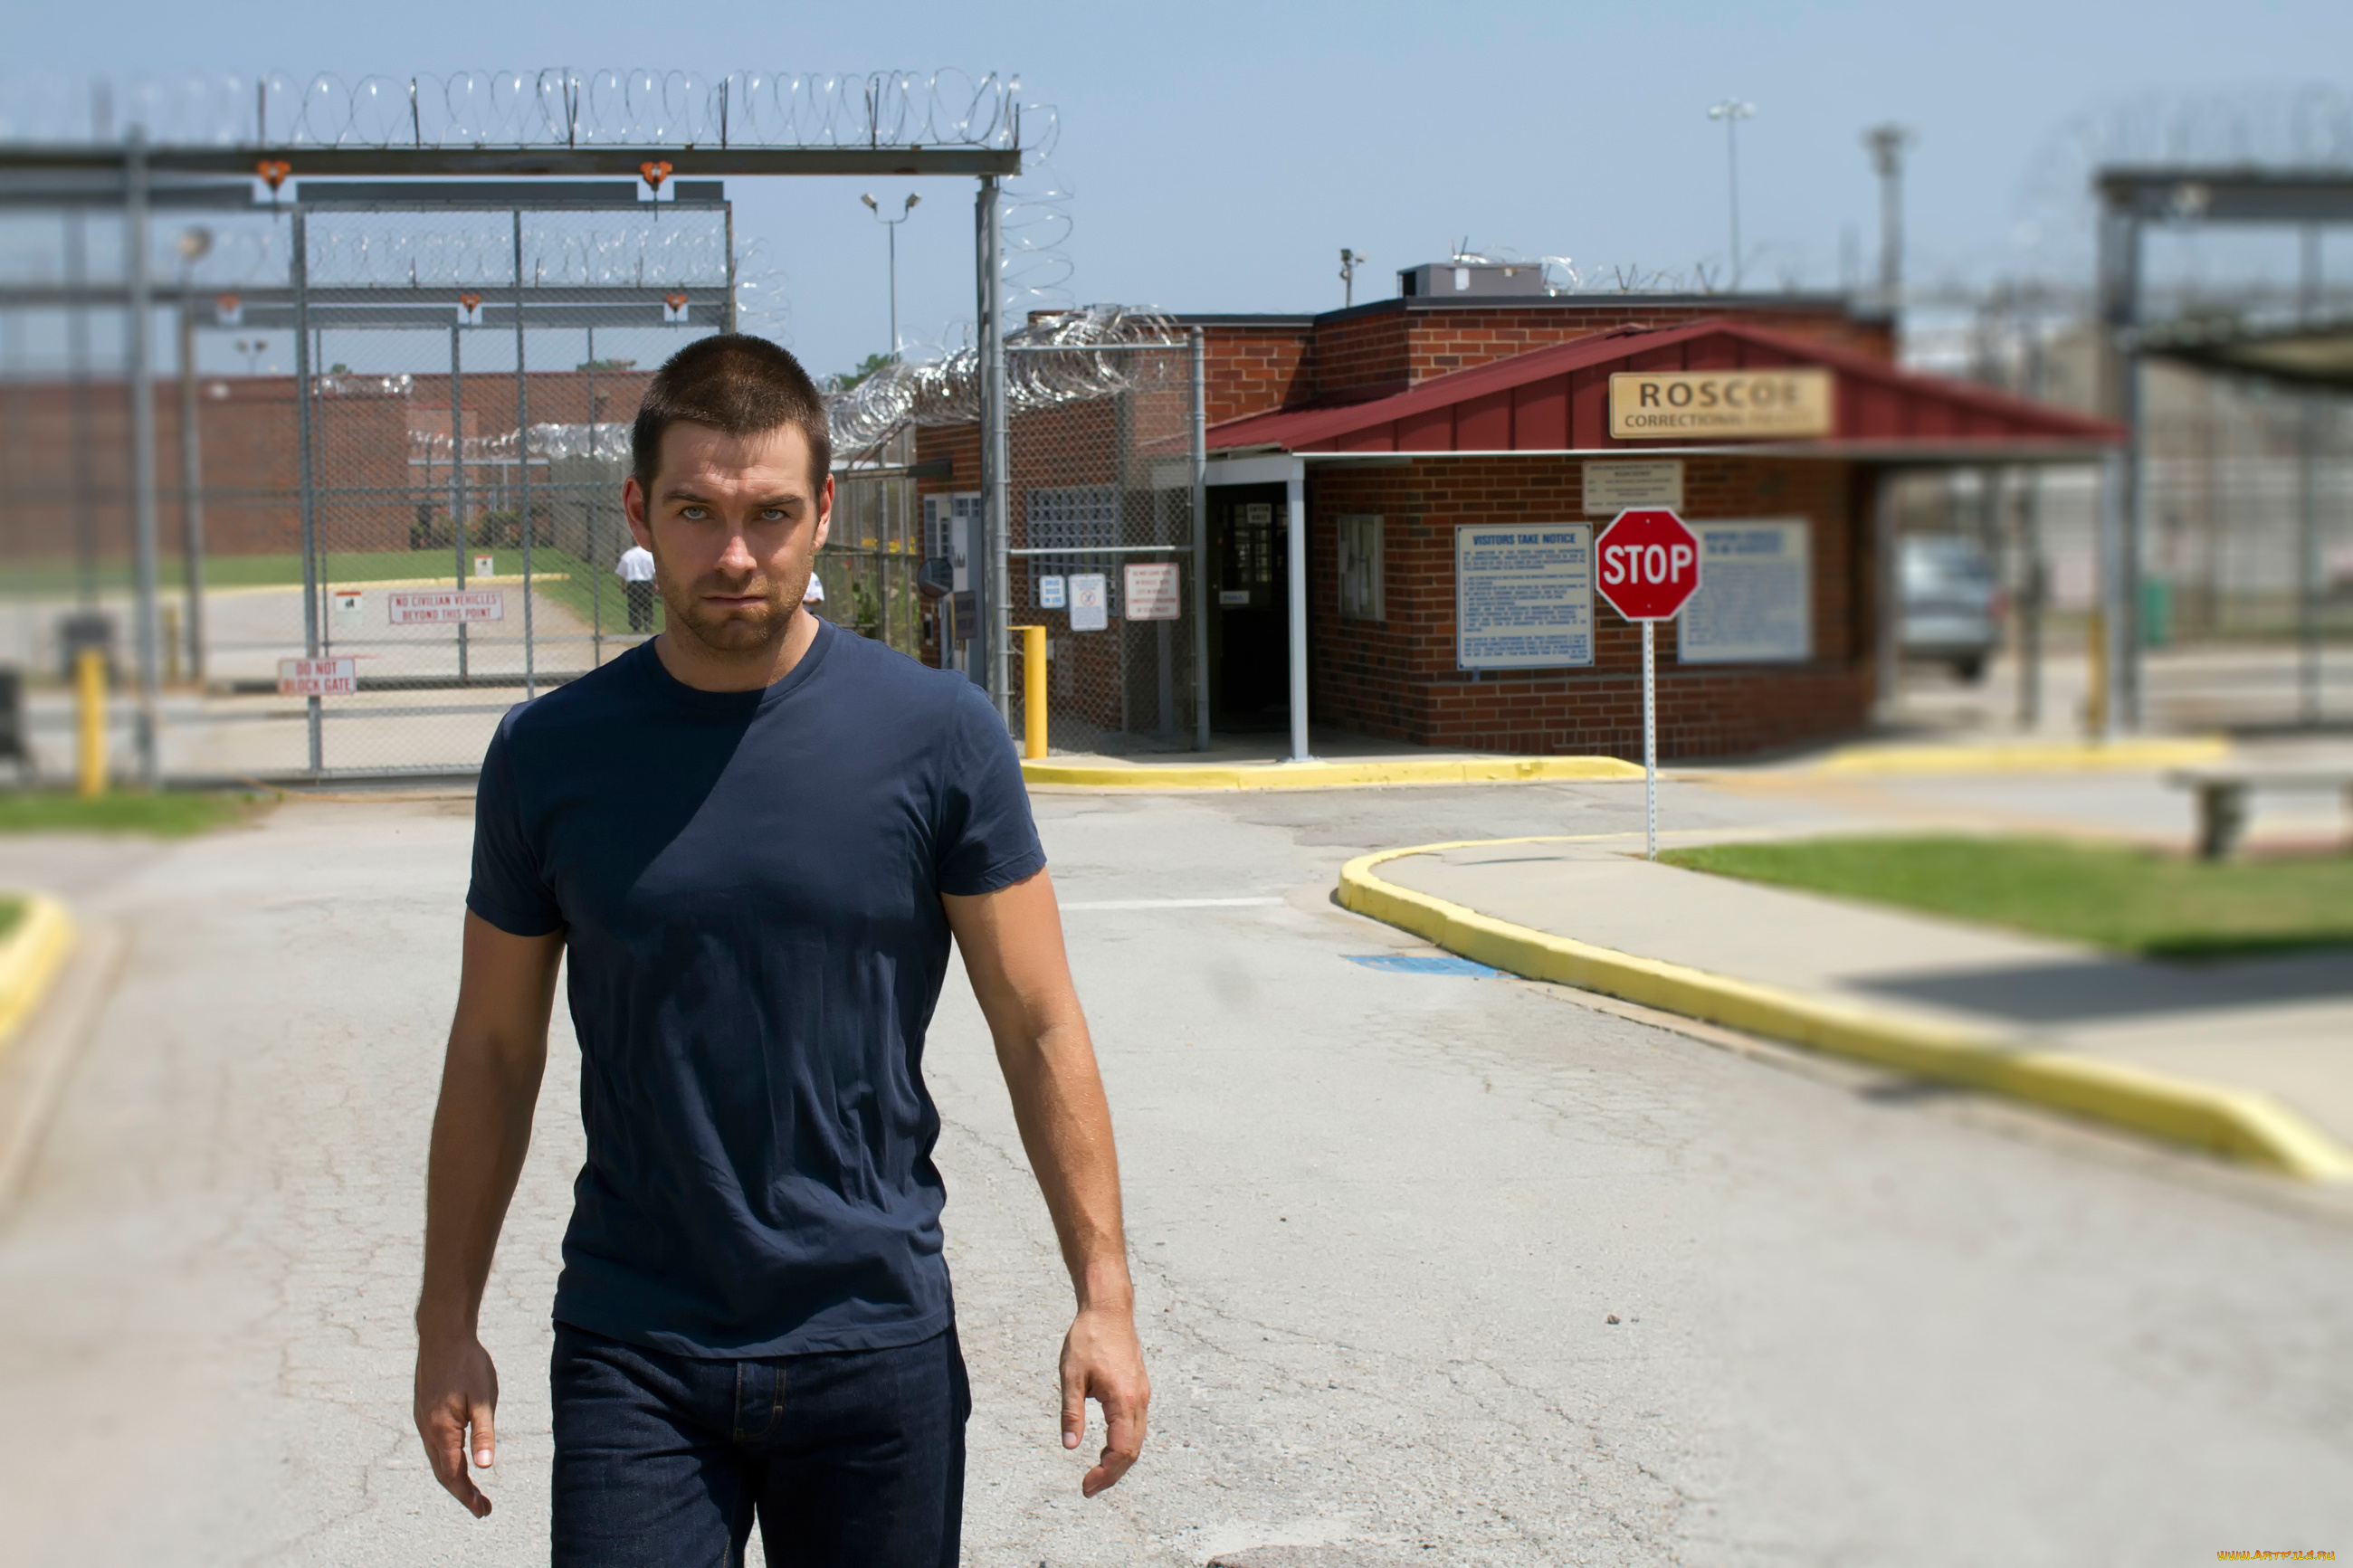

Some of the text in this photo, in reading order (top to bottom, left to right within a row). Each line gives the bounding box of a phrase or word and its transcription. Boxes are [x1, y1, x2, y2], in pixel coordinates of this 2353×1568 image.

[1639, 378, 1798, 409] ROSCOE
[1472, 532, 1577, 546] VISITORS TAKE NOTICE
[1603, 544, 1693, 585] STOP
[395, 594, 497, 607] NO CIVILIAN VEHICLES
[402, 607, 491, 622] BEYOND THIS POINT
[296, 660, 337, 676] DO NOT
[284, 677, 350, 693] BLOCK GATE
